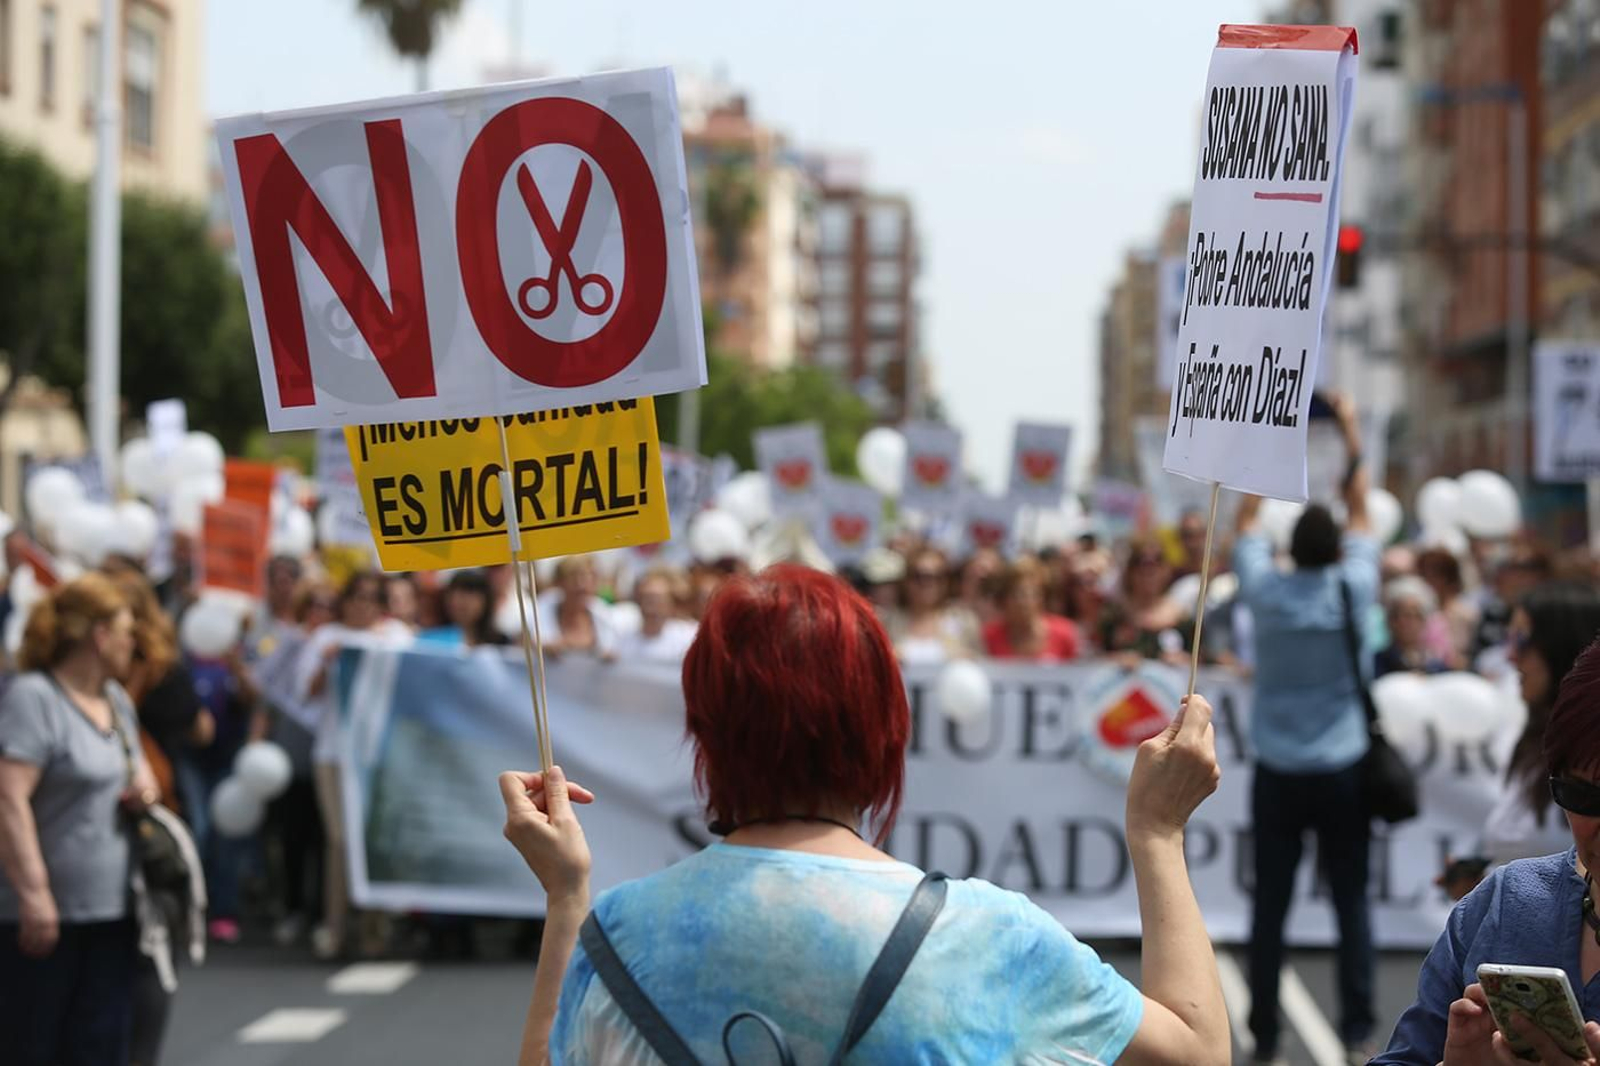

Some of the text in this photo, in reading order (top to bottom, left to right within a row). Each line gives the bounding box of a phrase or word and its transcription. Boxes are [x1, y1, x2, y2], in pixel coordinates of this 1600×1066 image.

[1202, 86, 1264, 180] SUSANA
[1255, 85, 1288, 181] NO
[234, 97, 667, 408] NO
[1183, 231, 1314, 326] ¡Pobre Andalucía
[1171, 342, 1307, 438] y España con Díaz!
[373, 474, 427, 536] ES
[440, 442, 648, 532] MORTAL!
